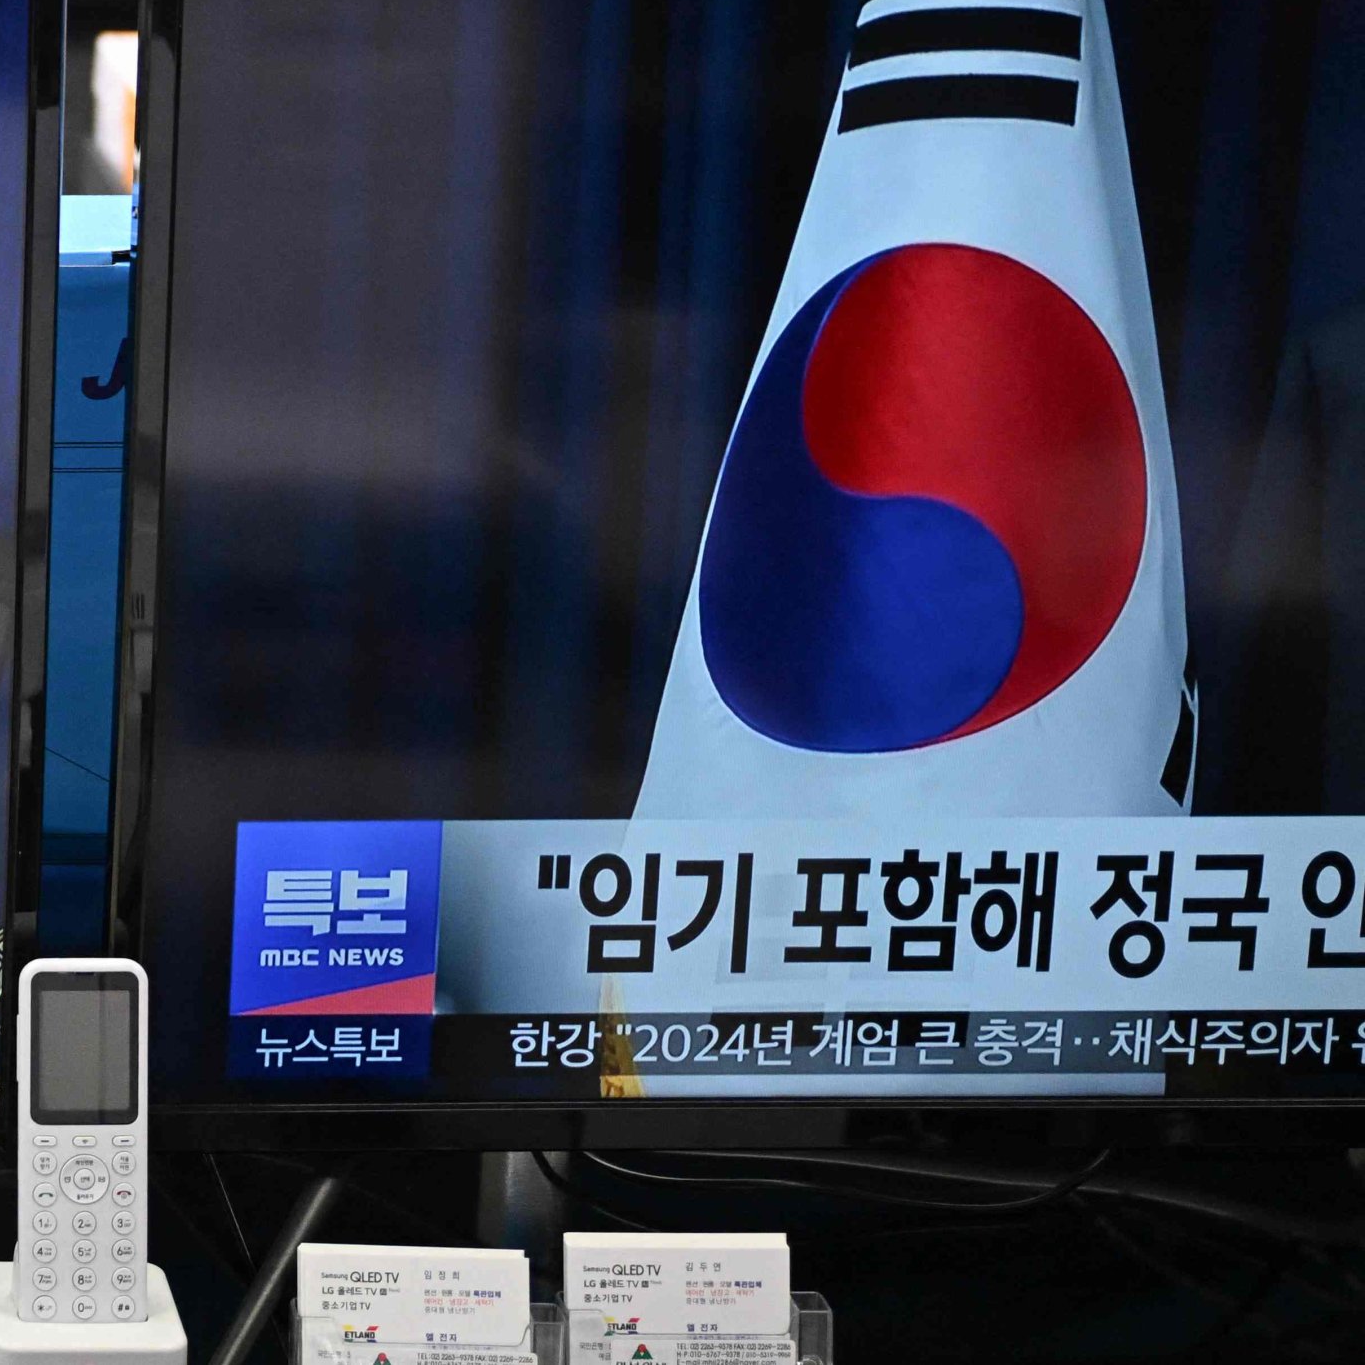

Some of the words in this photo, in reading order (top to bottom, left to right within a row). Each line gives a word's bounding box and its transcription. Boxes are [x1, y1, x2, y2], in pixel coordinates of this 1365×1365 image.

[263, 869, 408, 935] 특보
[538, 851, 755, 975] "임기
[789, 848, 1060, 975] 포함해
[1091, 852, 1272, 980] 정국
[260, 948, 320, 968] MBC
[327, 948, 404, 967] NEWS
[254, 1025, 403, 1067] 뉴스특보
[509, 1021, 598, 1068] 한강
[616, 1021, 793, 1068] "2024년
[808, 1021, 899, 1068] 계엄
[919, 1023, 965, 1067] 큰
[38, 1218, 44, 1229] 1
[77, 1218, 85, 1229] 2
[117, 1218, 124, 1229] 3
[36, 1246, 44, 1257] 4
[77, 1247, 84, 1257] 5
[116, 1246, 124, 1257] 6
[583, 1265, 610, 1275] Samsung
[612, 1264, 645, 1276] QLED
[646, 1265, 662, 1276] TV
[37, 1274, 44, 1284] 7
[77, 1275, 85, 1285] 8
[116, 1274, 123, 1284] 9
[321, 1272, 349, 1281] Samsung
[350, 1271, 383, 1284] QLED
[384, 1272, 400, 1284] TV
[583, 1280, 596, 1288] LG
[599, 1279, 625, 1289] 올레드
[627, 1280, 639, 1289] TV
[321, 1286, 335, 1295] LG
[337, 1286, 363, 1296] 올레드
[365, 1287, 378, 1296] TV
[584, 1294, 620, 1303] 중소기업
[621, 1294, 633, 1303] TV
[77, 1302, 85, 1313] 0
[321, 1300, 358, 1311] 중소기업
[359, 1301, 371, 1311] TV
[700, 1323, 718, 1333] 전자
[344, 1331, 376, 1339] ETLAND
[439, 1333, 458, 1343] 전자
